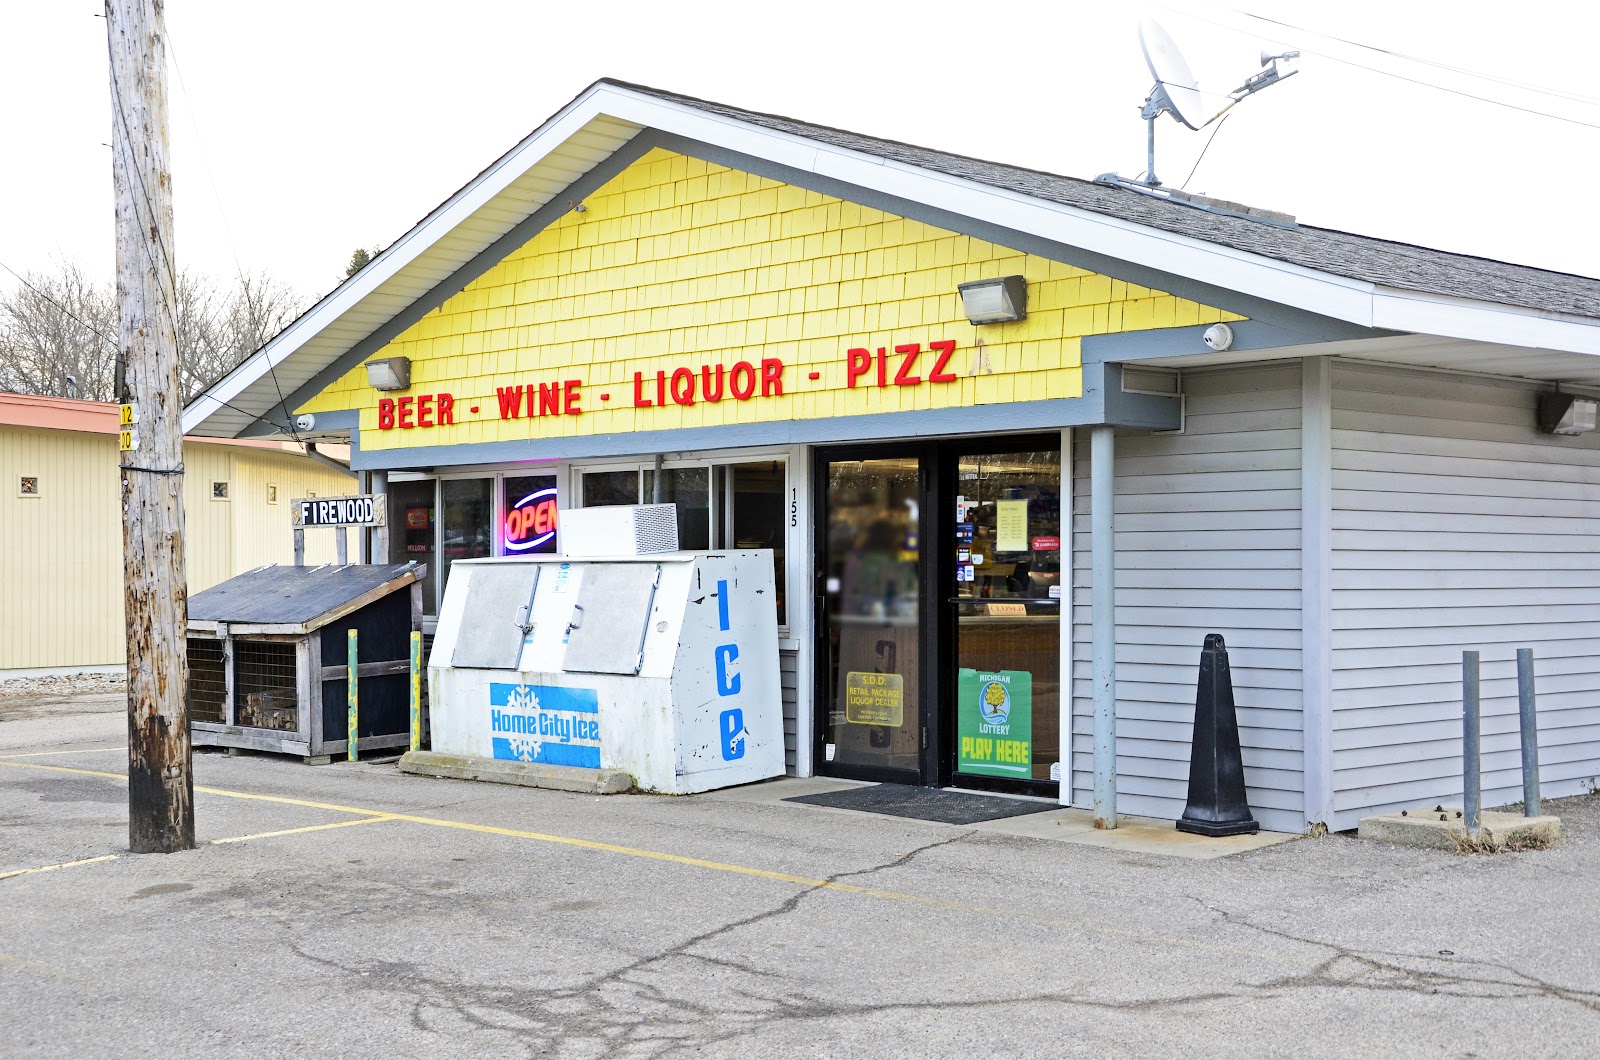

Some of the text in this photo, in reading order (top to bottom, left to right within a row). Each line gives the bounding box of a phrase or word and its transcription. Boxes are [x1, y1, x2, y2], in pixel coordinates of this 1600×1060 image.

[378, 392, 454, 430] BEER
[497, 379, 582, 420] WINE
[633, 357, 784, 408] LIQUOR
[121, 405, 132, 423] 12
[301, 498, 374, 525] FIREWOOD
[506, 499, 557, 542] OPEN
[990, 605, 1024, 613] CLOSED
[979, 674, 1011, 684] MICHIGAN
[849, 687, 900, 698] RETAIL PACKAGE
[850, 696, 899, 707] LIQUOR DEALER
[491, 709, 599, 743] Home City Ice
[979, 722, 1010, 735] LOTTERY
[961, 736, 1029, 764] PLAY HERE
